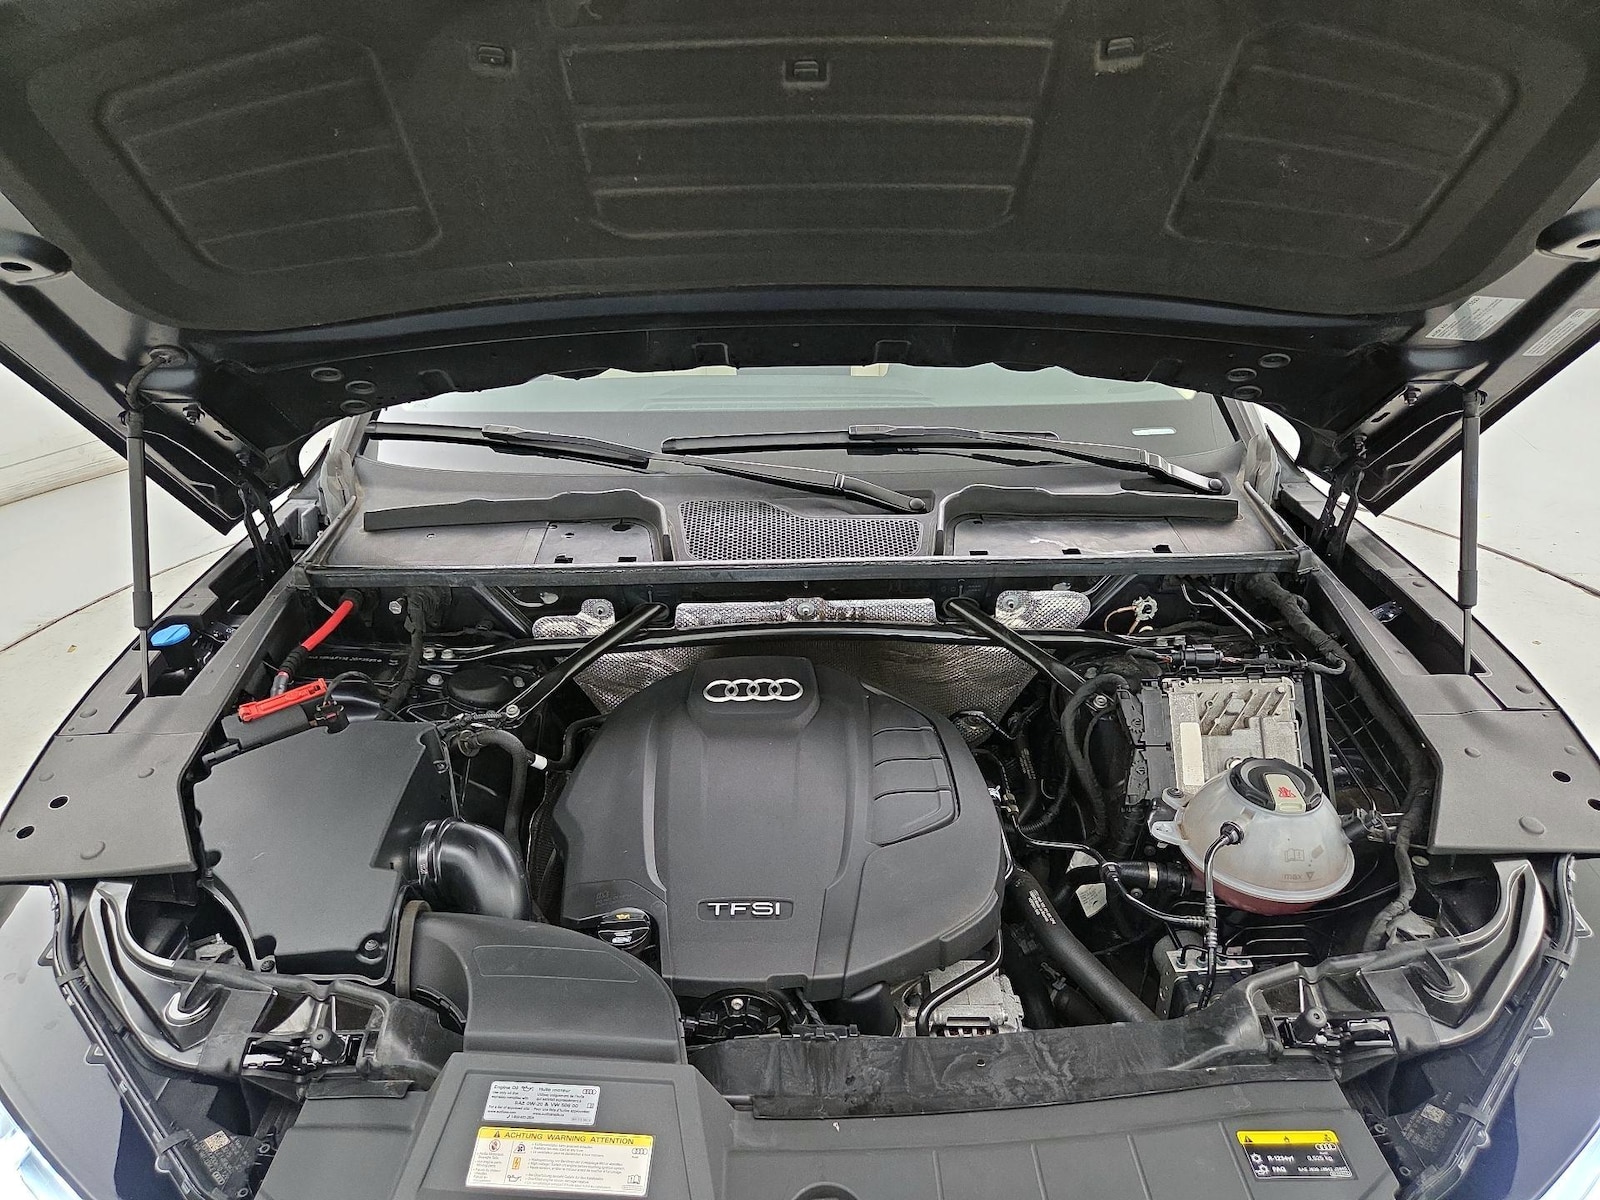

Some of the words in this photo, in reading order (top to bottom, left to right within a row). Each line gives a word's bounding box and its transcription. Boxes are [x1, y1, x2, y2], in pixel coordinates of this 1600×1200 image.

[707, 902, 780, 916] TFSI
[504, 1132, 543, 1140] ACHTUNG
[547, 1134, 586, 1142] WARNING
[590, 1136, 634, 1145] ATTENTION
